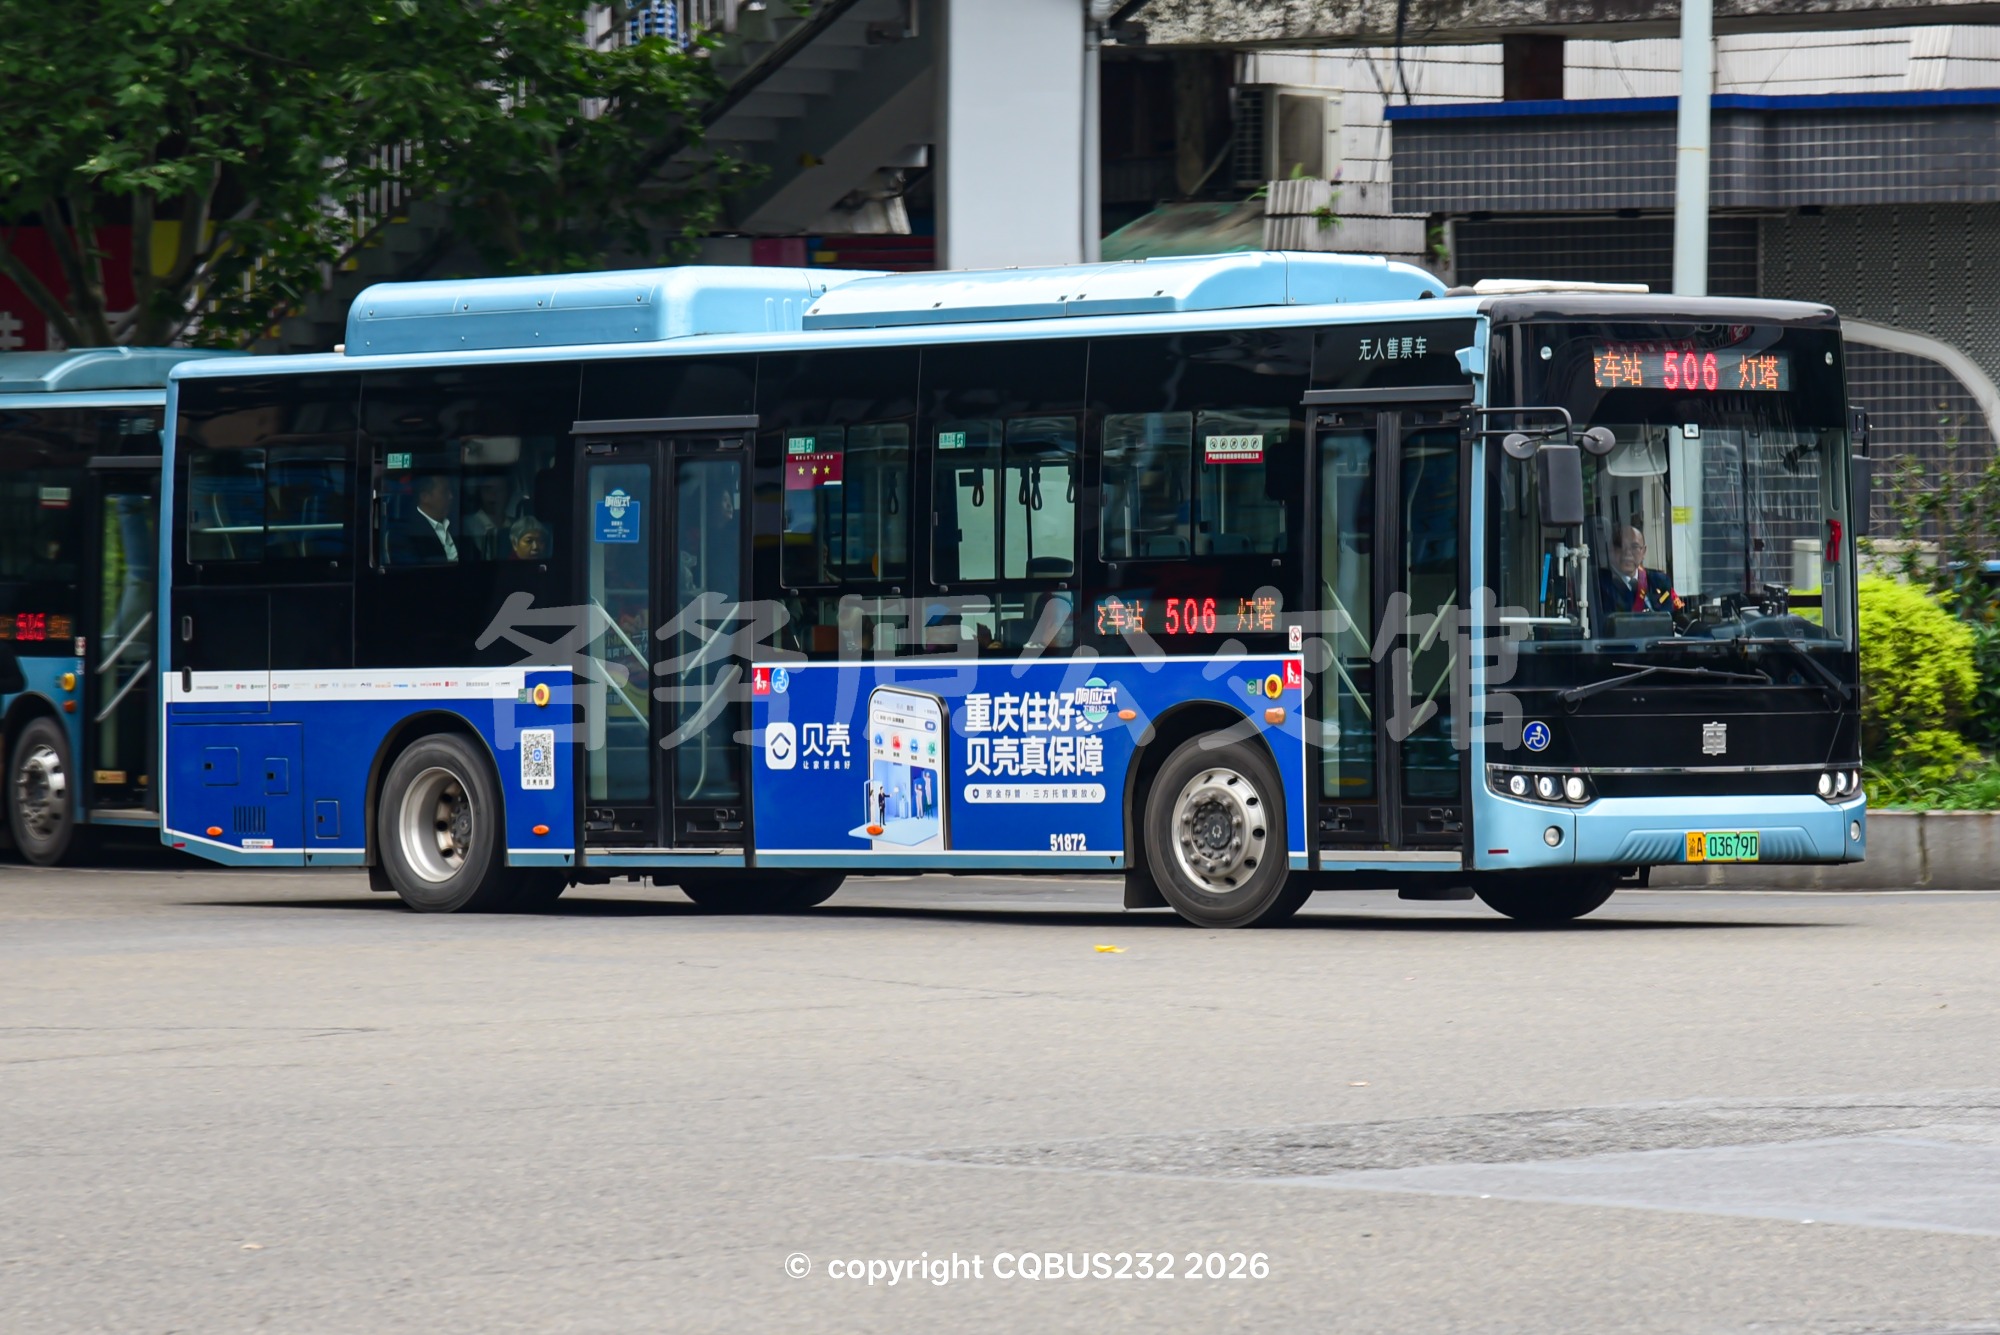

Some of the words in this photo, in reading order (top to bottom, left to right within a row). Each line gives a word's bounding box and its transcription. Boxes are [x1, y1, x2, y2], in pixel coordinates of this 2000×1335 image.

[1359, 335, 1427, 361] 无人售票车
[1663, 352, 1718, 390] 506
[1738, 354, 1779, 390] 灯塔
[1165, 597, 1217, 635] 506
[1237, 597, 1276, 632] 灯塔
[1075, 687, 1117, 705] 响应式
[802, 722, 851, 757] 贝壳
[802, 760, 851, 770] 让家更美好
[964, 735, 1104, 777] 贝壳真保障
[1050, 833, 1087, 851] 51872
